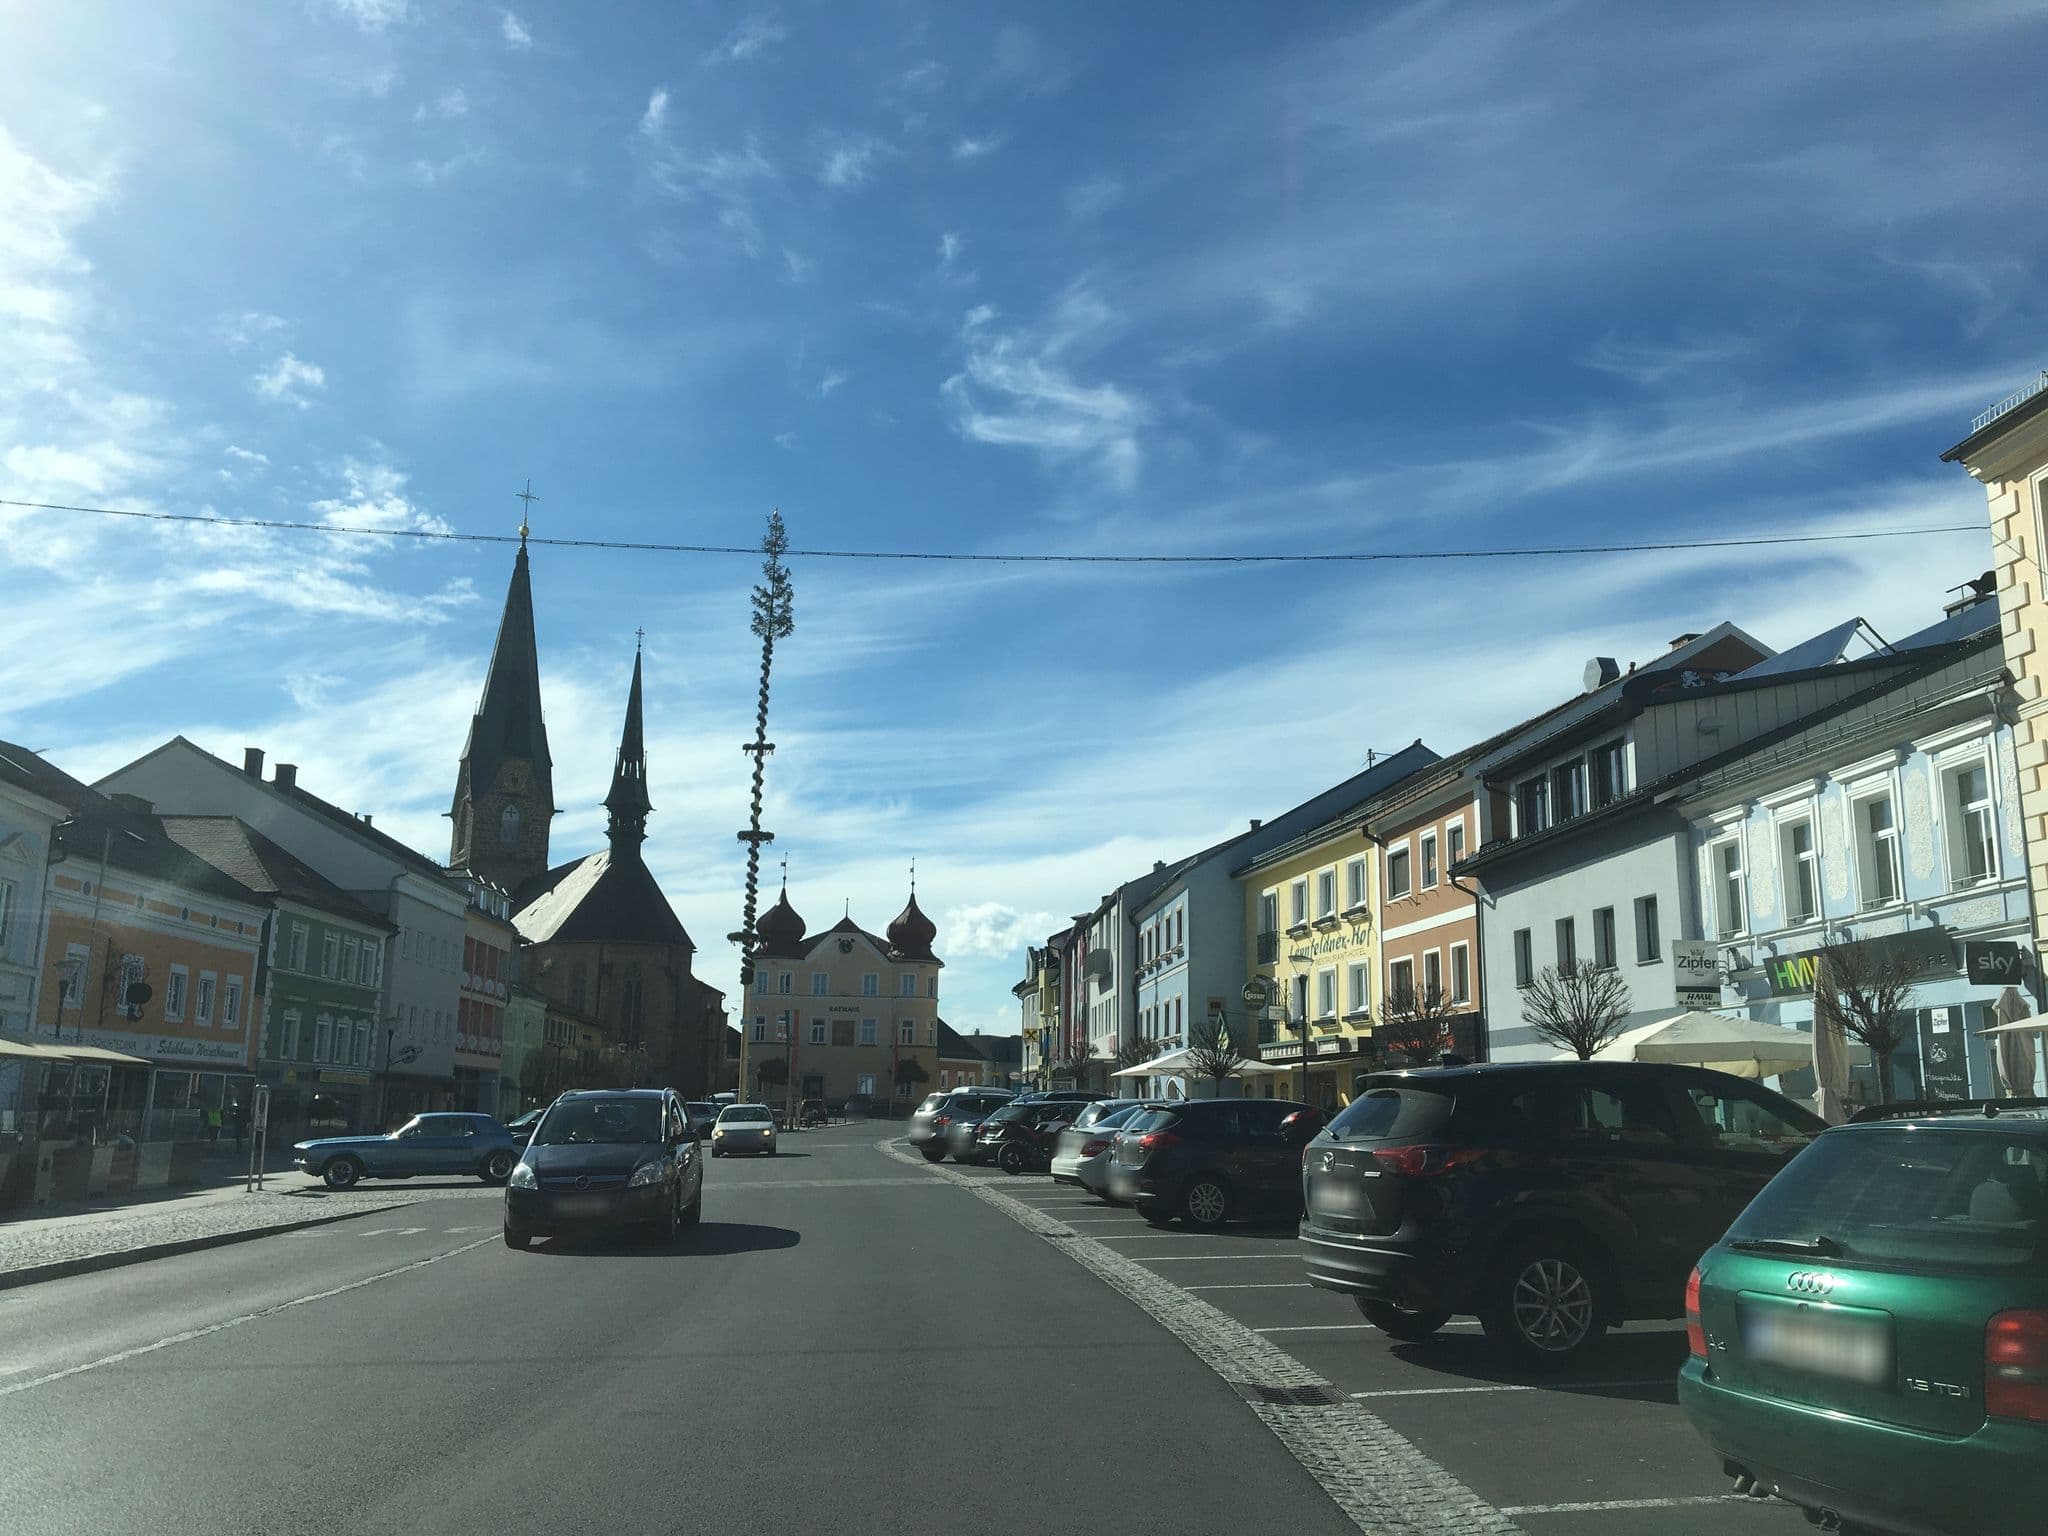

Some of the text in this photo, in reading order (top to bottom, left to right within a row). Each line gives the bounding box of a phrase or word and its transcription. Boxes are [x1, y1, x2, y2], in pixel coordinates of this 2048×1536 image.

[1677, 955, 1717, 970] Zipfer
[1978, 951, 2014, 975] sky
[1686, 993, 1714, 1001] HMW
